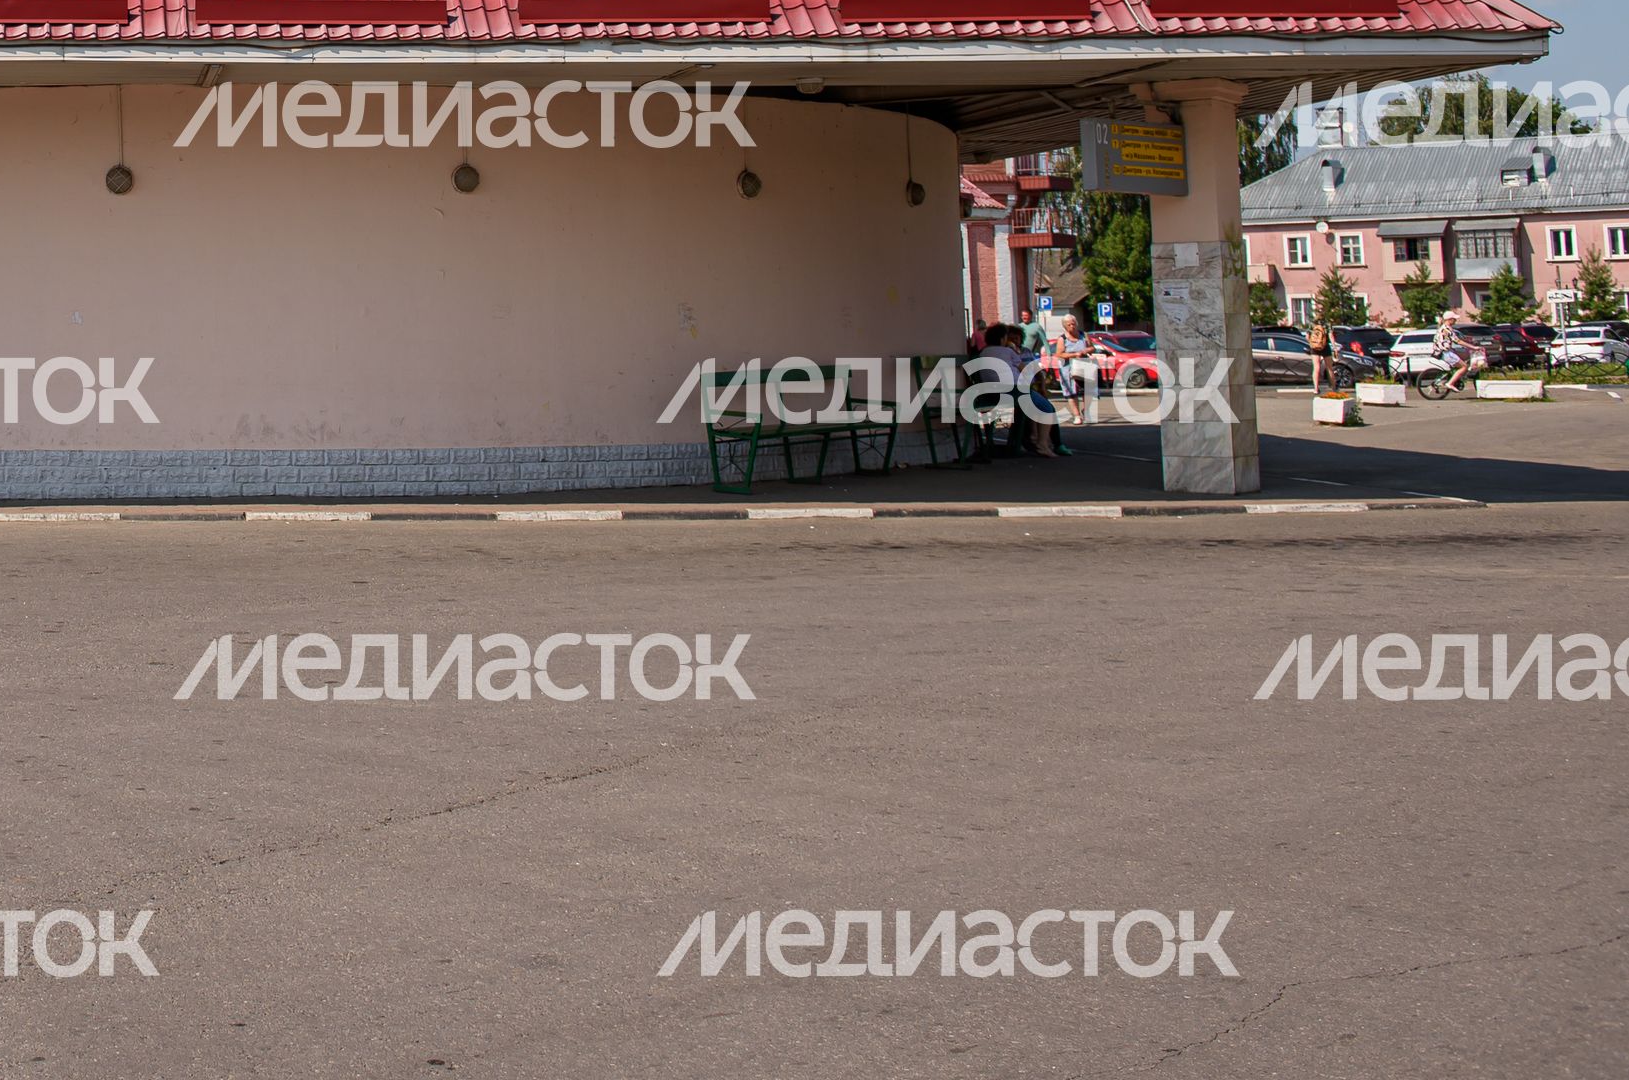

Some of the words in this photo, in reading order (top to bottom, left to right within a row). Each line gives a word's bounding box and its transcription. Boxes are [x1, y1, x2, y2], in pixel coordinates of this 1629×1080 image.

[1096, 123, 1109, 145] 02
[1041, 298, 1049, 308] P
[1102, 304, 1110, 316] P
